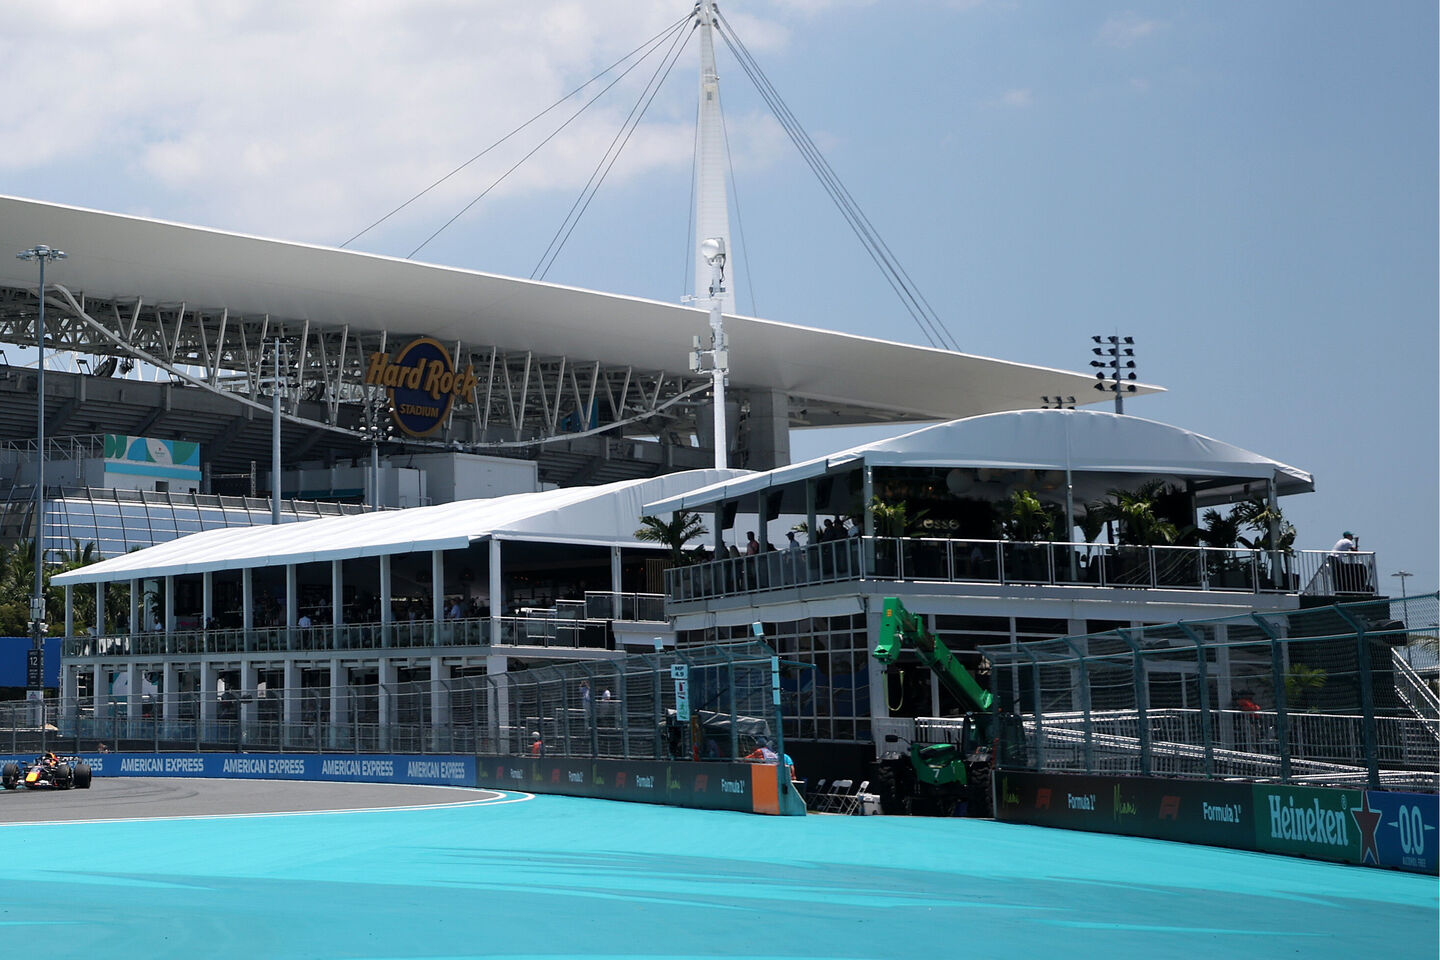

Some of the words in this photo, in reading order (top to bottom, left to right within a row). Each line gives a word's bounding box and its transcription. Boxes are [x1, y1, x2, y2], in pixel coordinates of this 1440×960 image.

[365, 352, 427, 390] Hard
[424, 360, 478, 404] Rock
[400, 404, 439, 418] STADIUM
[29, 656, 38, 666] 12
[121, 758, 163, 772] AMERICAN
[166, 758, 204, 772] EXPRESS
[223, 759, 266, 773] AMERICAN
[269, 760, 304, 774] EXPRESS
[322, 760, 360, 775] AMERICAN
[362, 760, 393, 776] EXPRESS
[408, 761, 439, 778] AMERICAN
[441, 762, 464, 779] EXPRESS
[933, 769, 940, 778] 7
[1068, 794, 1089, 810] Formula
[1203, 802, 1233, 823] Formula
[1268, 794, 1349, 846] Heineken
[1398, 805, 1424, 855] 0.0
